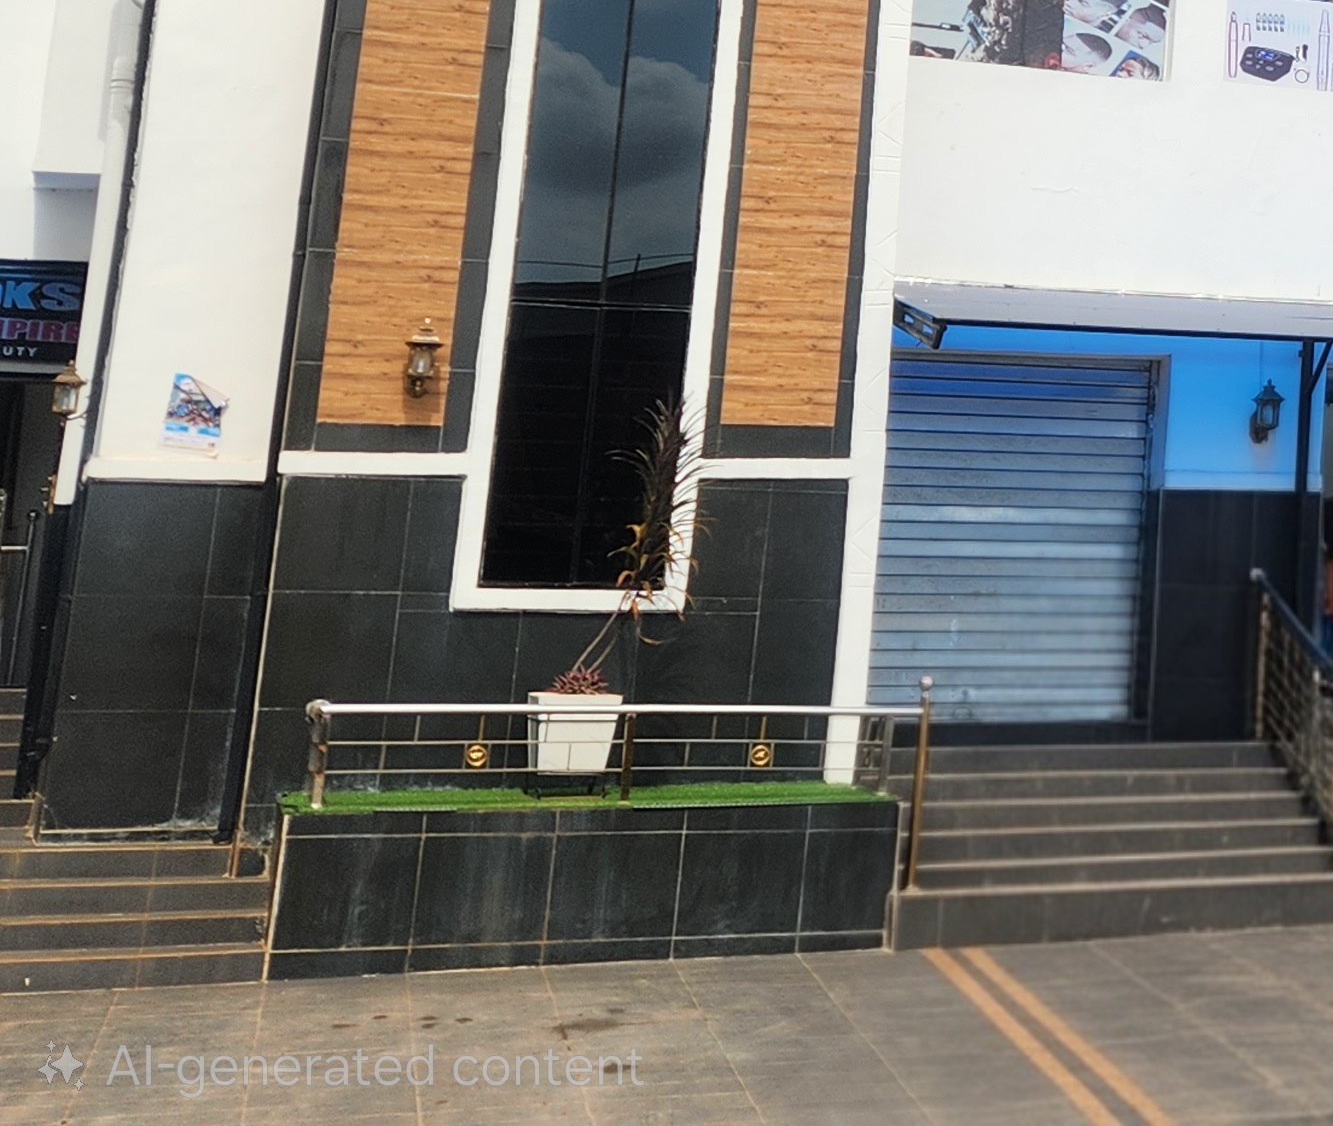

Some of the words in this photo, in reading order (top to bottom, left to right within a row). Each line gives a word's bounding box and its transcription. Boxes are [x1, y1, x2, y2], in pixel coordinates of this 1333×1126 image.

[0, 280, 81, 311] KS
[0, 318, 80, 343] PIRE
[2, 346, 38, 357] UTY
